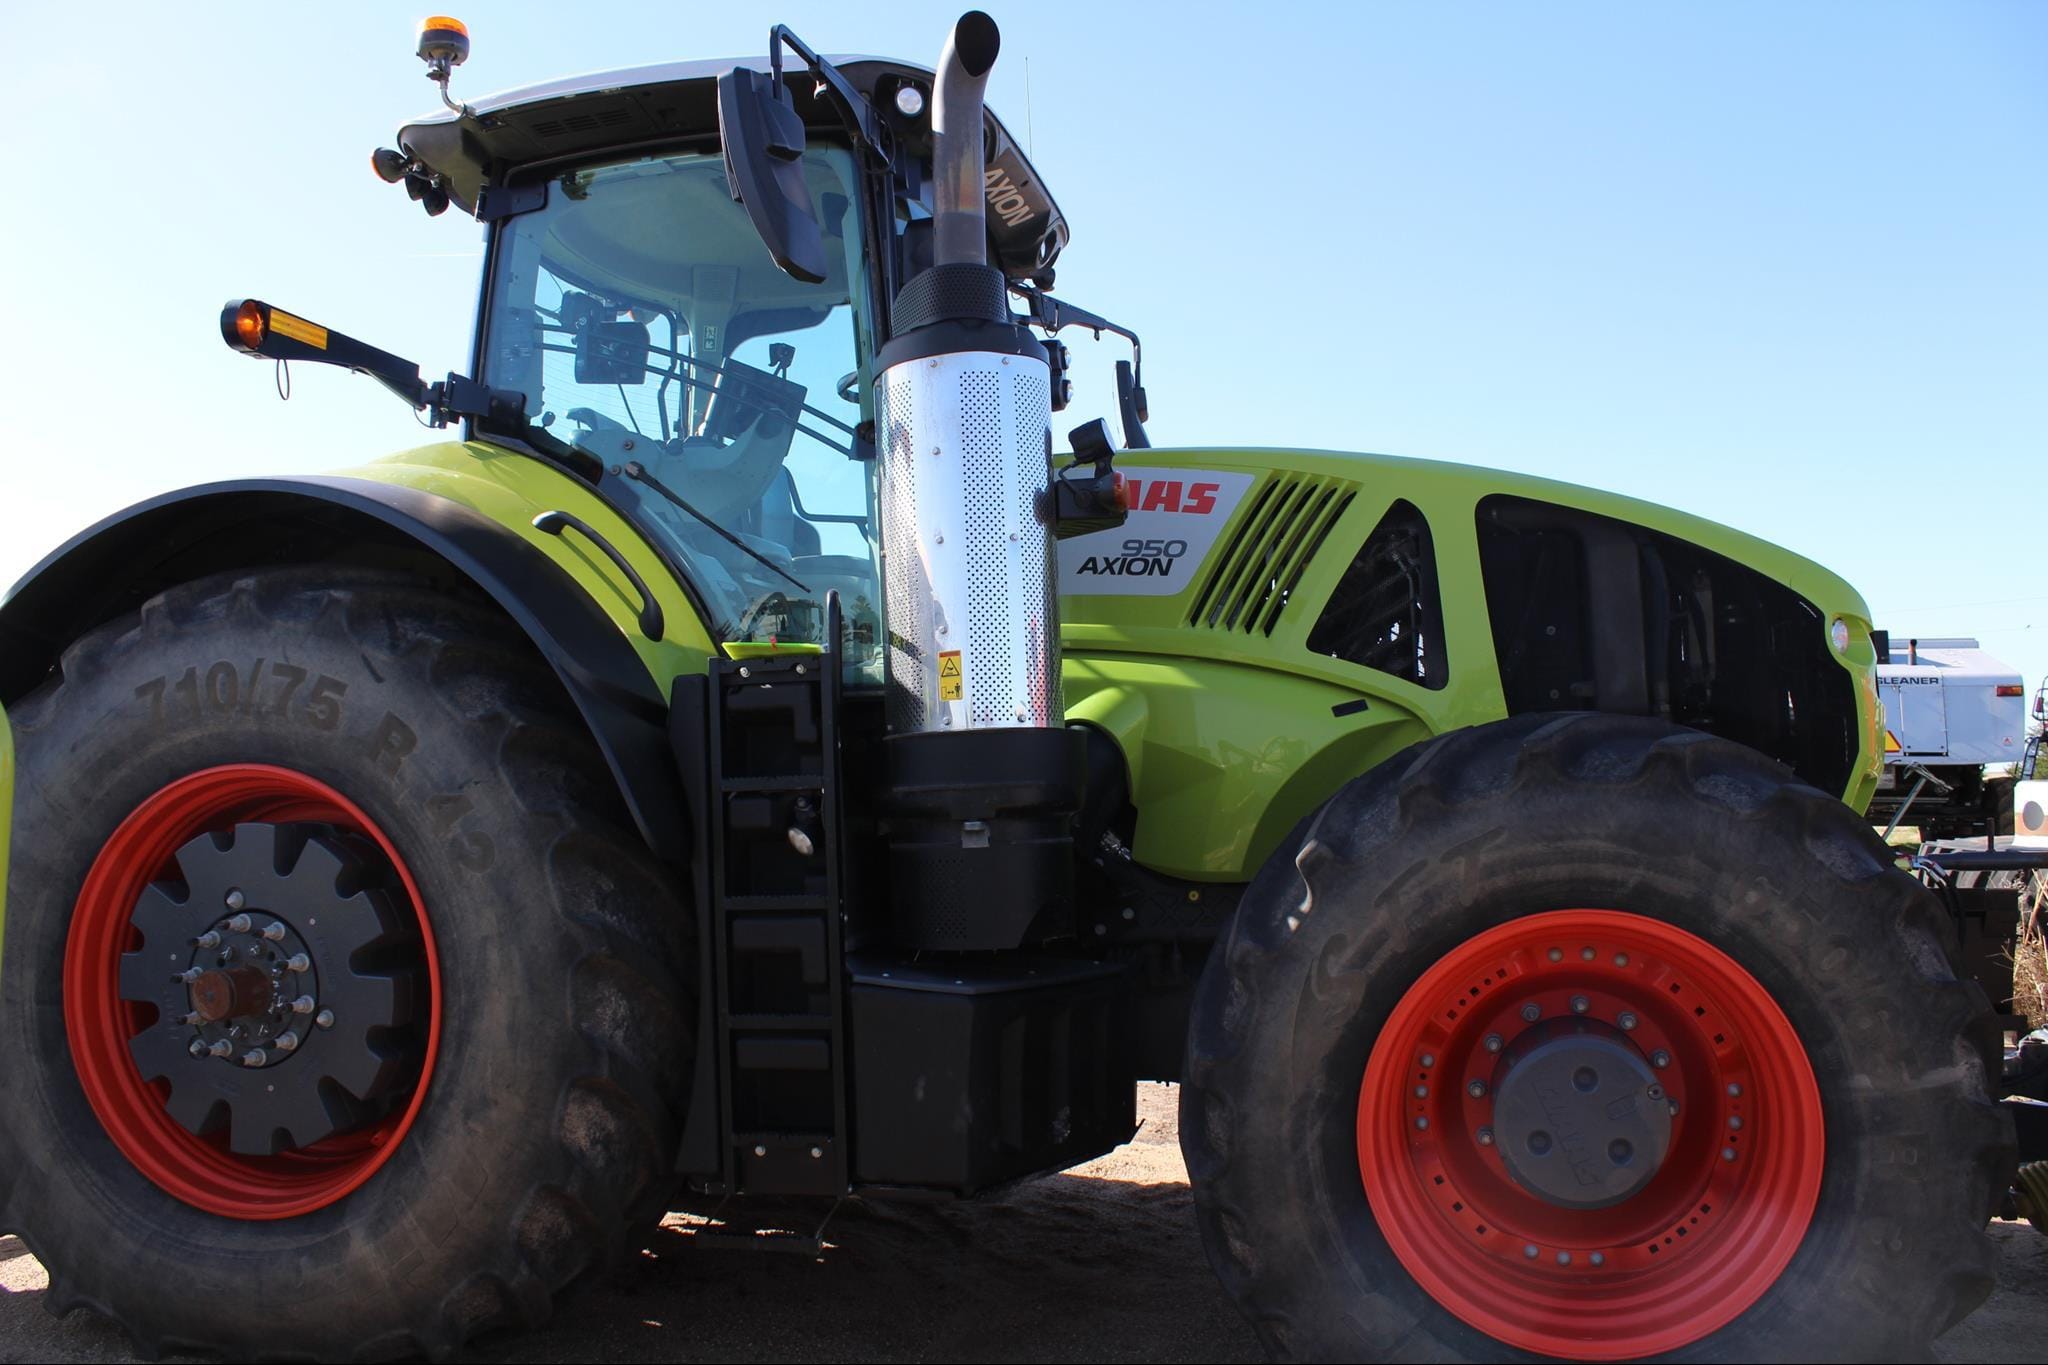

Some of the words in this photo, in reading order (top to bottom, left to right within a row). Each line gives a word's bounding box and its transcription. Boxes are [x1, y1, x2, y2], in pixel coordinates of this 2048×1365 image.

[984, 168, 1034, 227] AXION
[1076, 556, 1174, 577] AXION
[1120, 539, 1188, 558] 950
[134, 657, 349, 730] 710/75
[367, 711, 417, 776] R
